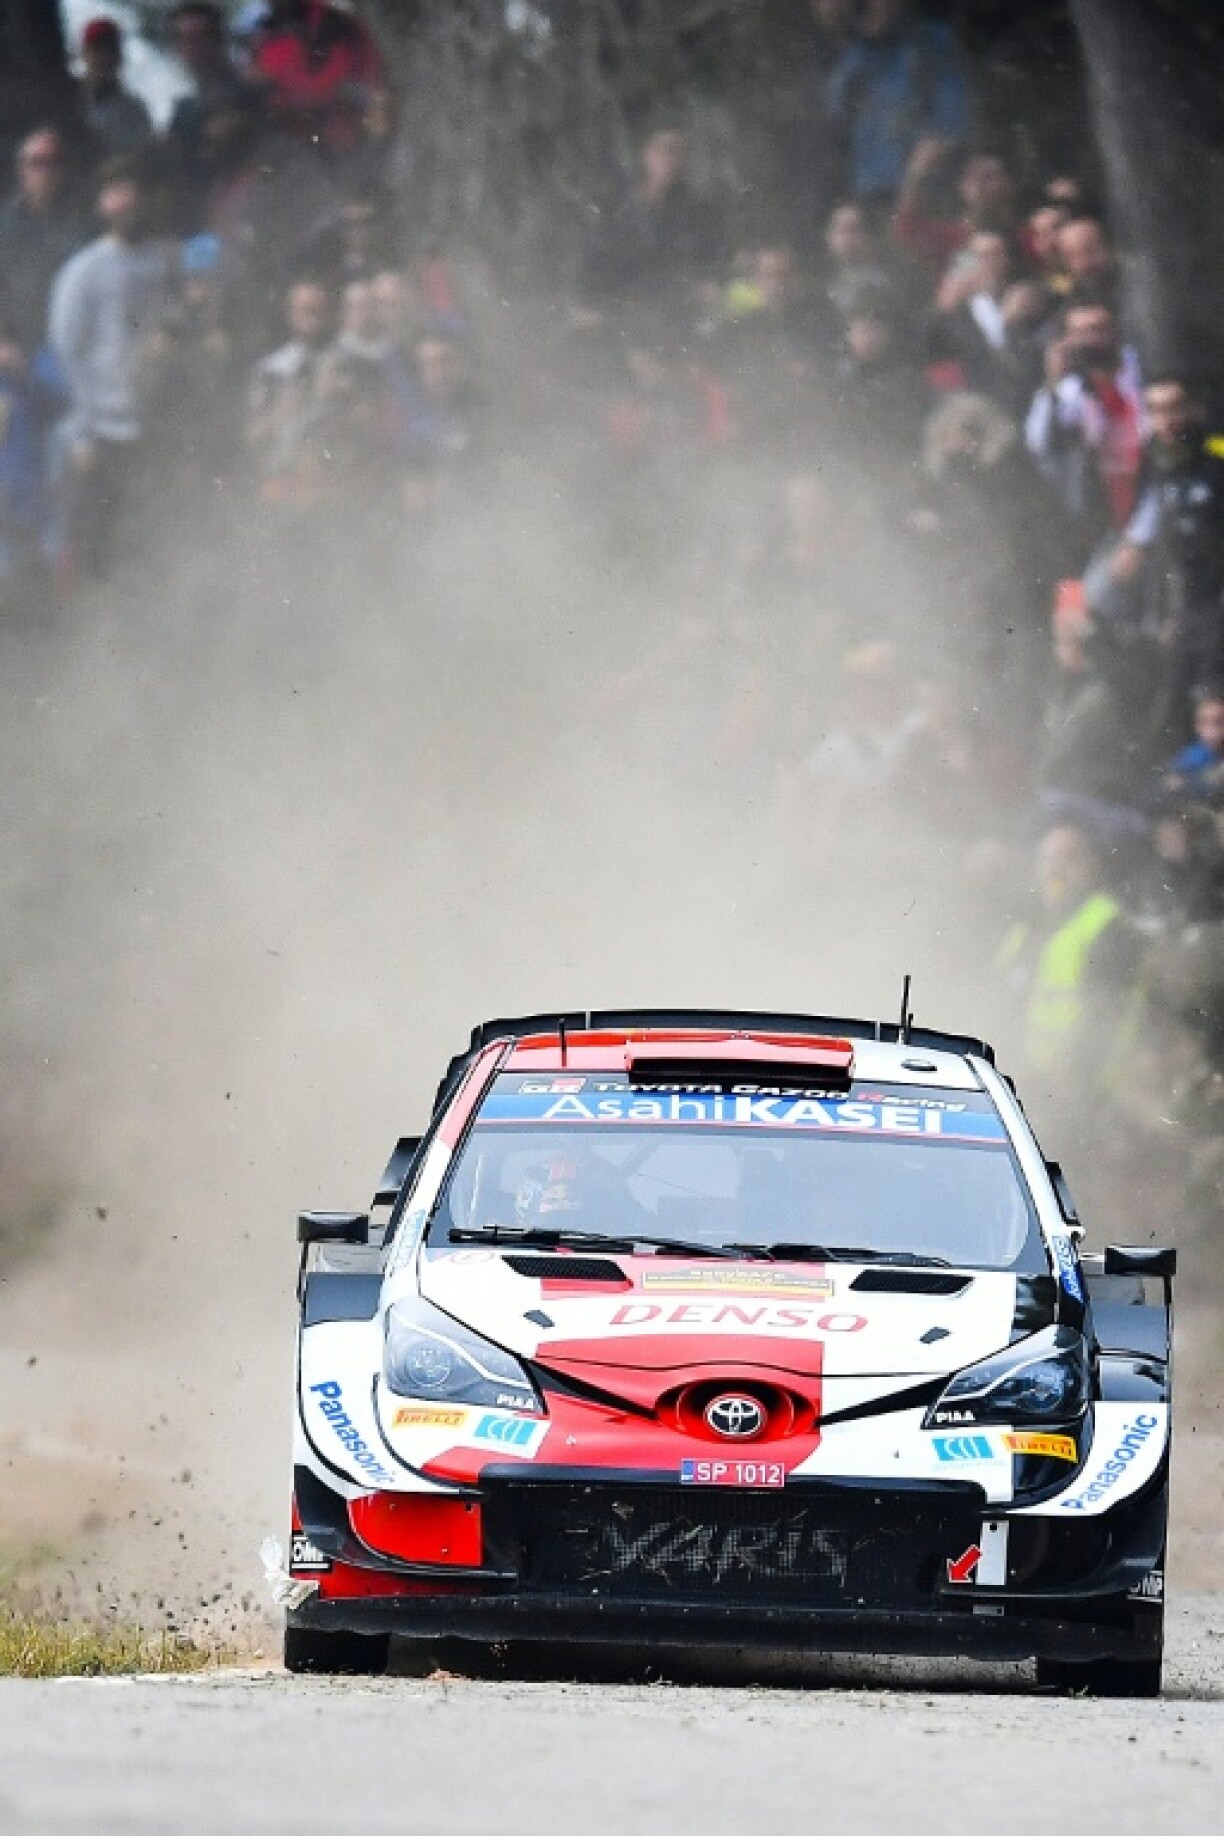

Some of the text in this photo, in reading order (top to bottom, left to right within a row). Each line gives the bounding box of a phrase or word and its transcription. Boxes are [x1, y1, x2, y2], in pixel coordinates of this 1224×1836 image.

[593, 1081, 723, 1093] TOYOTA
[731, 1084, 849, 1099] GAZOO
[857, 1092, 967, 1112] Racing
[609, 1304, 868, 1332] DENSO
[496, 1393, 534, 1408] PIAA
[394, 1409, 465, 1426] PIRELLI
[936, 1409, 976, 1423] PIAA
[309, 1381, 396, 1483] Panasonic
[1006, 1436, 1073, 1457] PIRELLI
[1060, 1414, 1158, 1509] Panasonic
[697, 1462, 780, 1483] SP 1012
